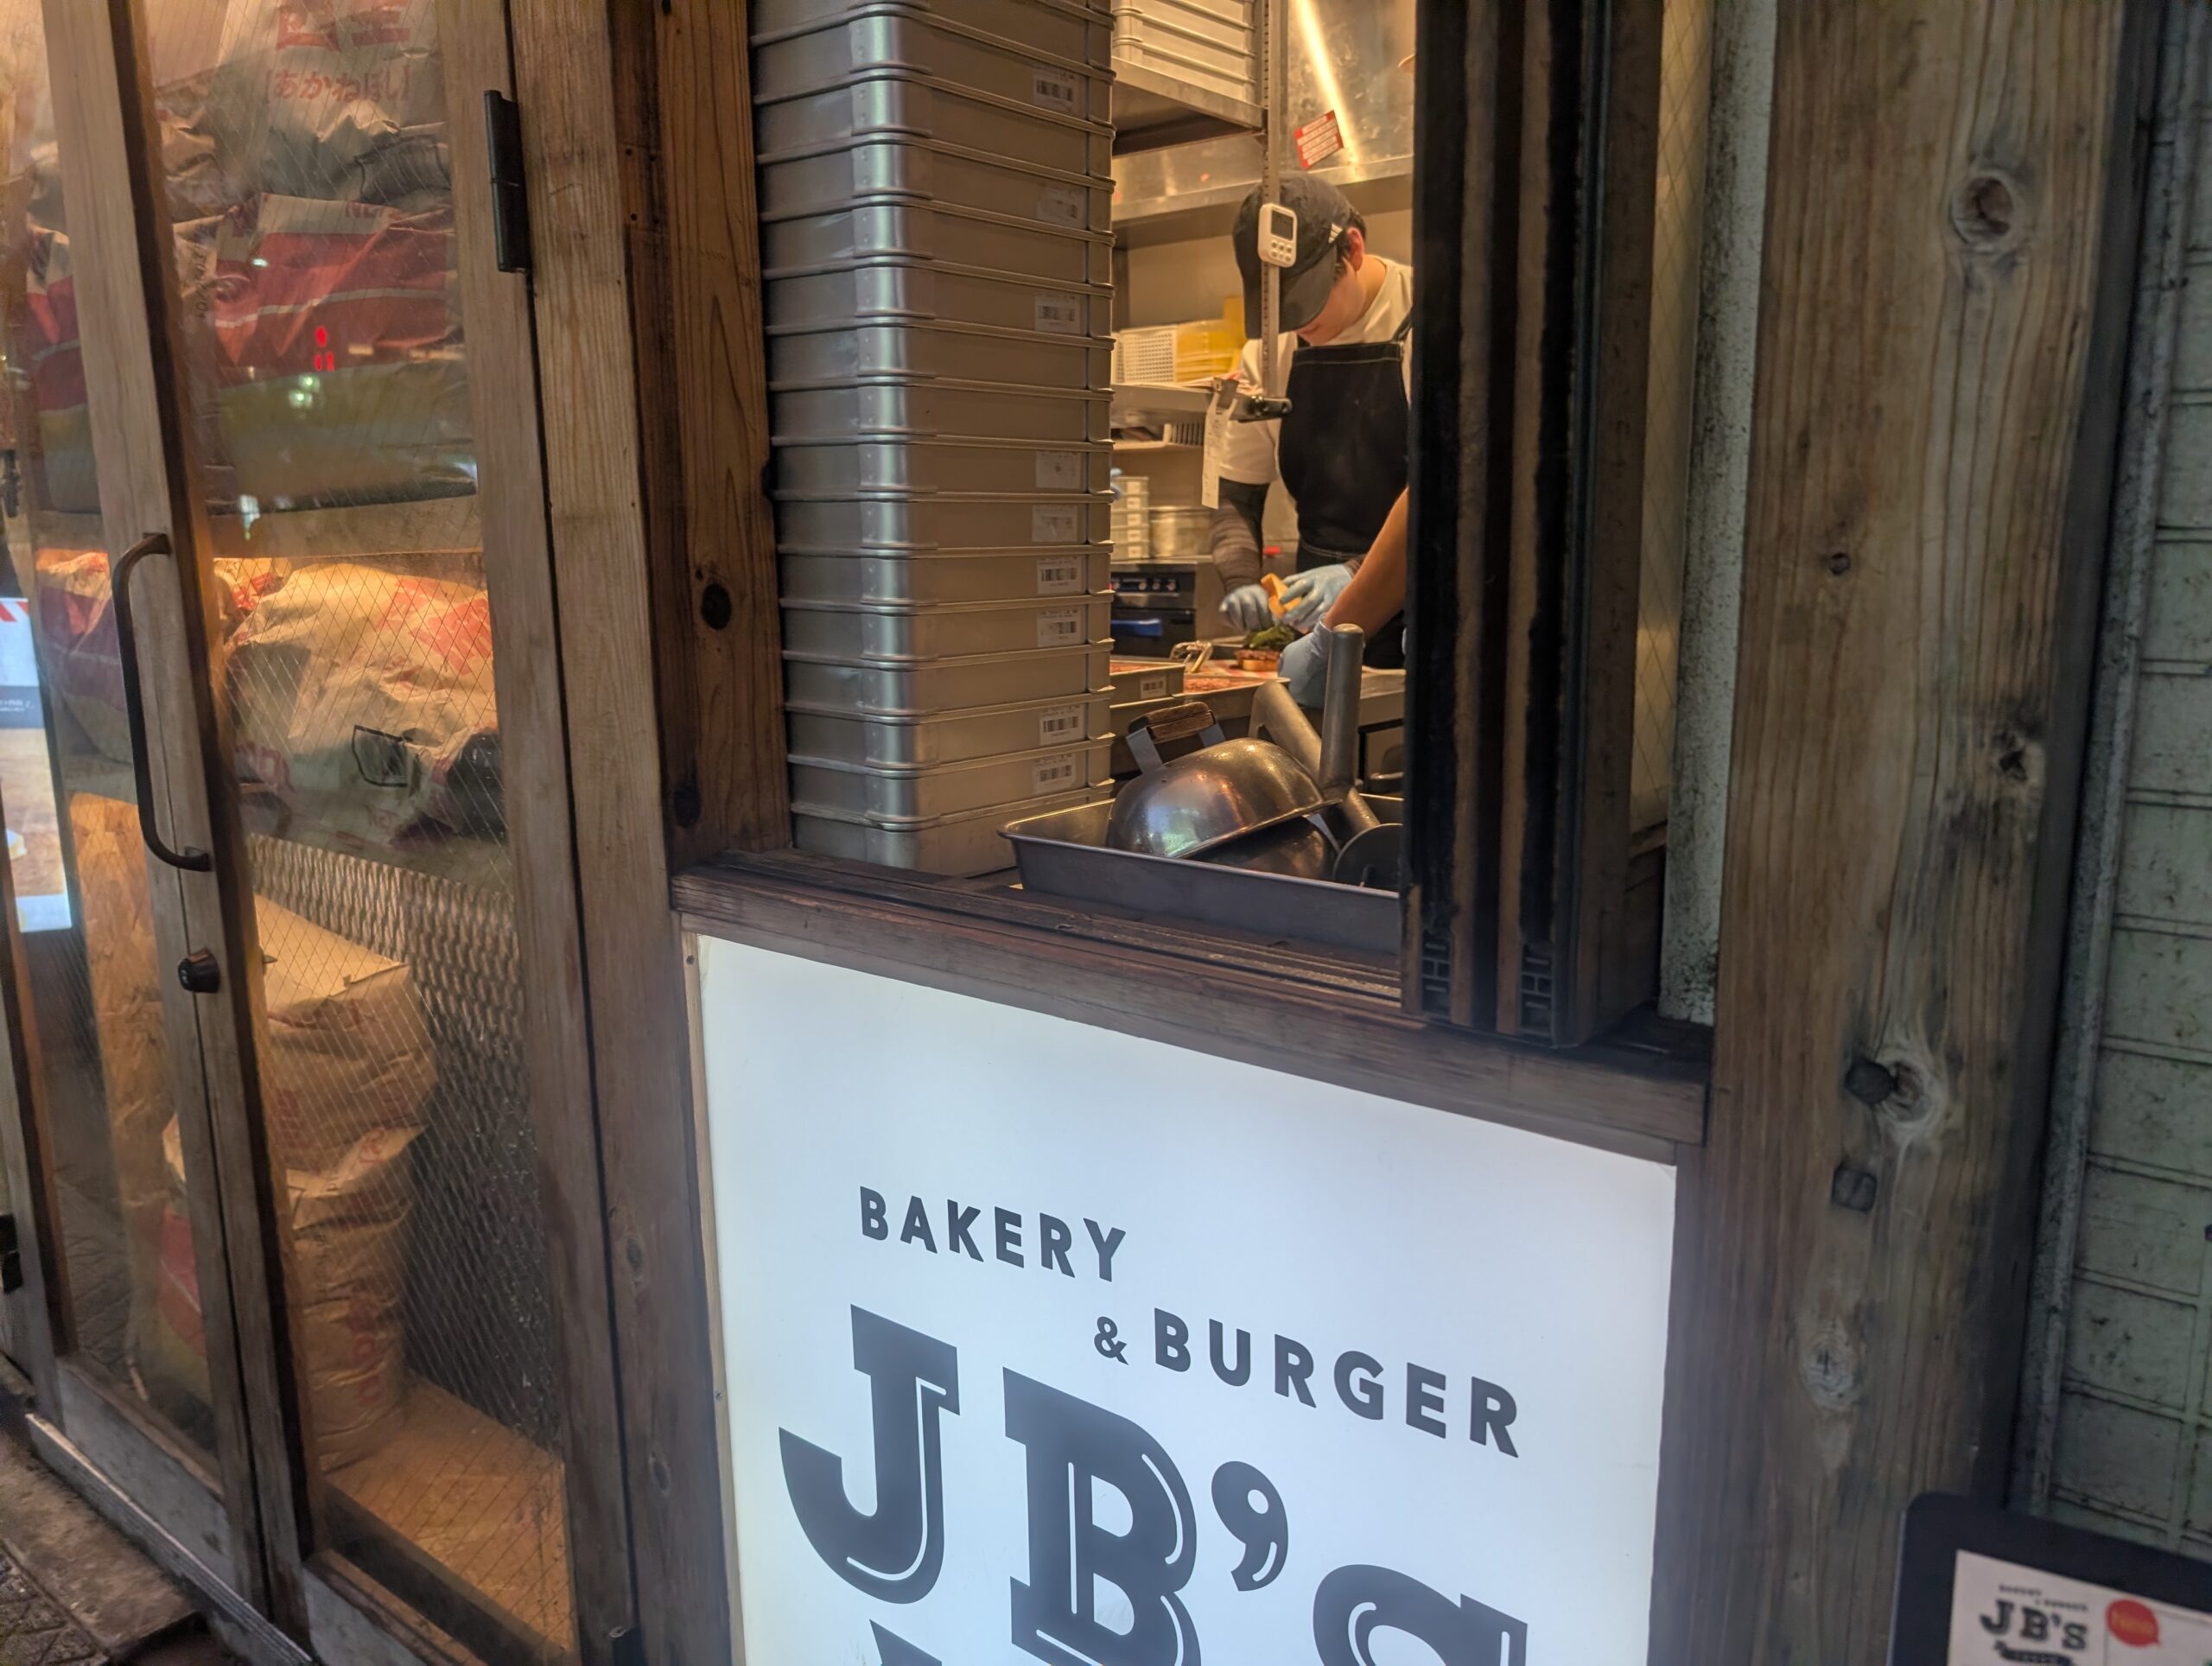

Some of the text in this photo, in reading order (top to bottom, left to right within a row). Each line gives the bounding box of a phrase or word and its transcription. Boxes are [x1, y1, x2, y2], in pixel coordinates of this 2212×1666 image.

[860, 1186, 1127, 1282] BAKERY
[1094, 1307, 1519, 1459] & BURGER
[1979, 1598, 2089, 1652] JB'S
